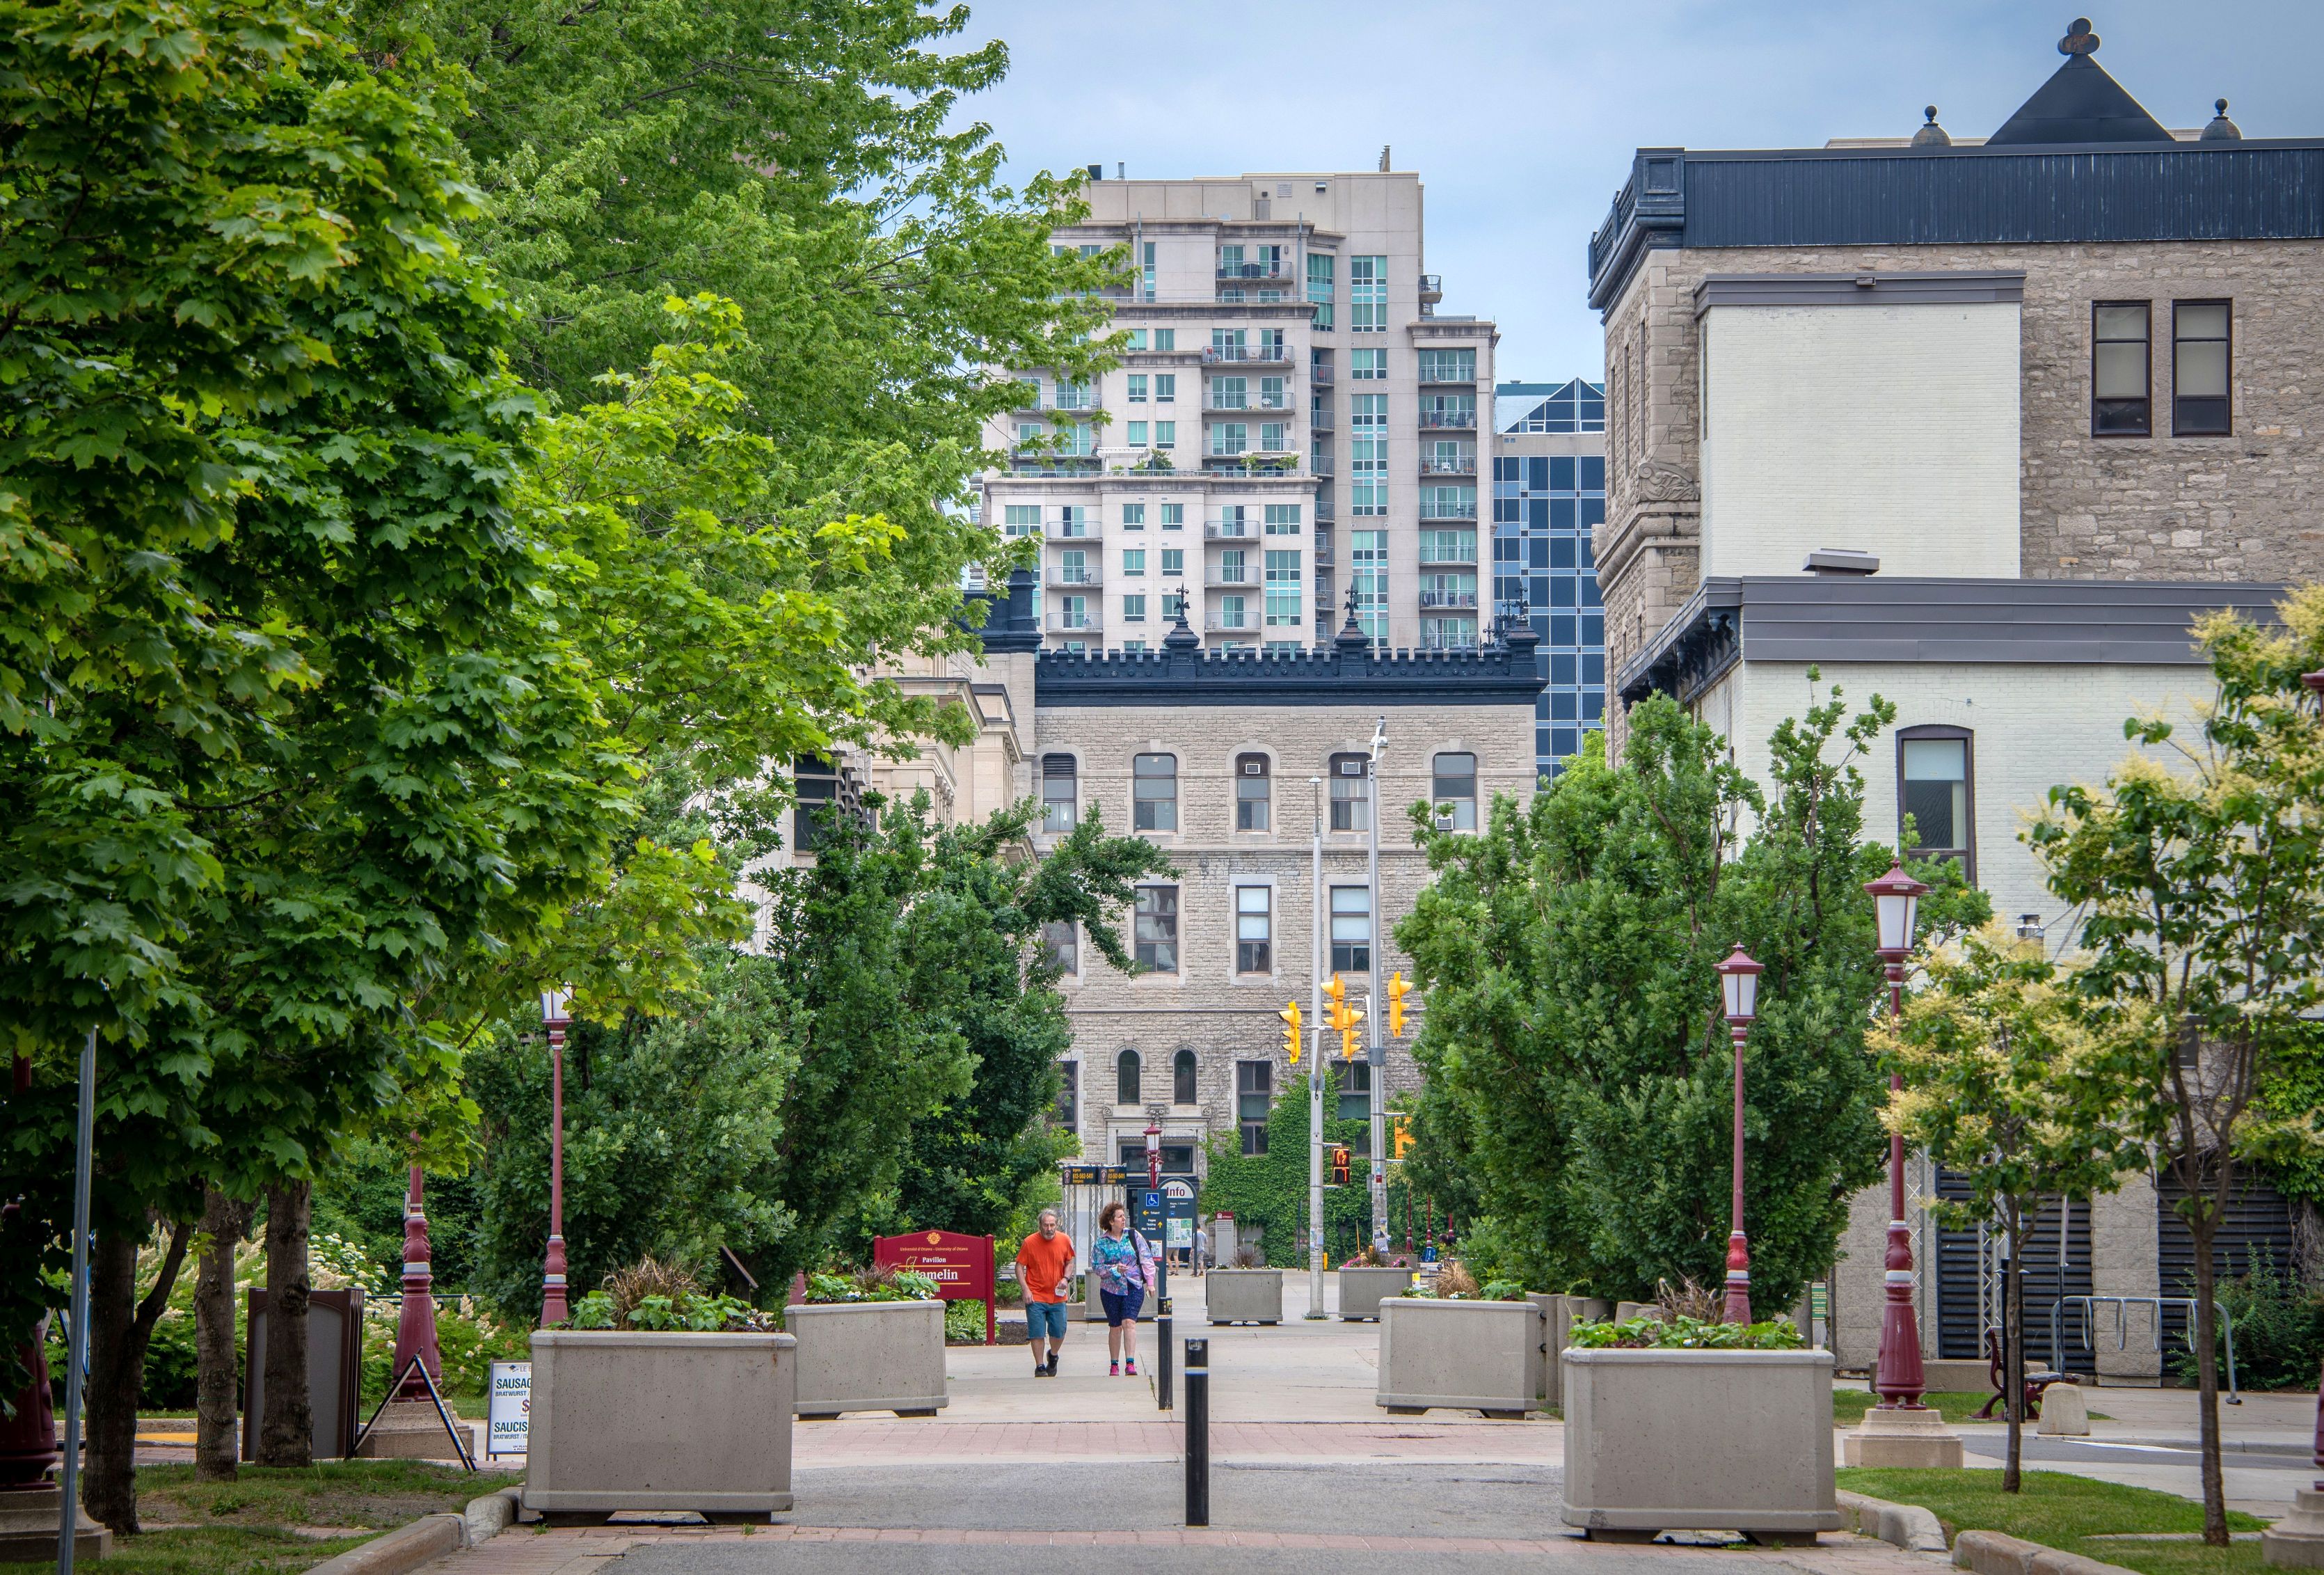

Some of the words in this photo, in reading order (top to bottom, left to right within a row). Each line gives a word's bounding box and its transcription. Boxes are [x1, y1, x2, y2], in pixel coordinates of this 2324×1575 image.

[1167, 1187, 1185, 1196] Info
[911, 1269, 958, 1280] amelin
[495, 1421, 527, 1432] SAUCIS
